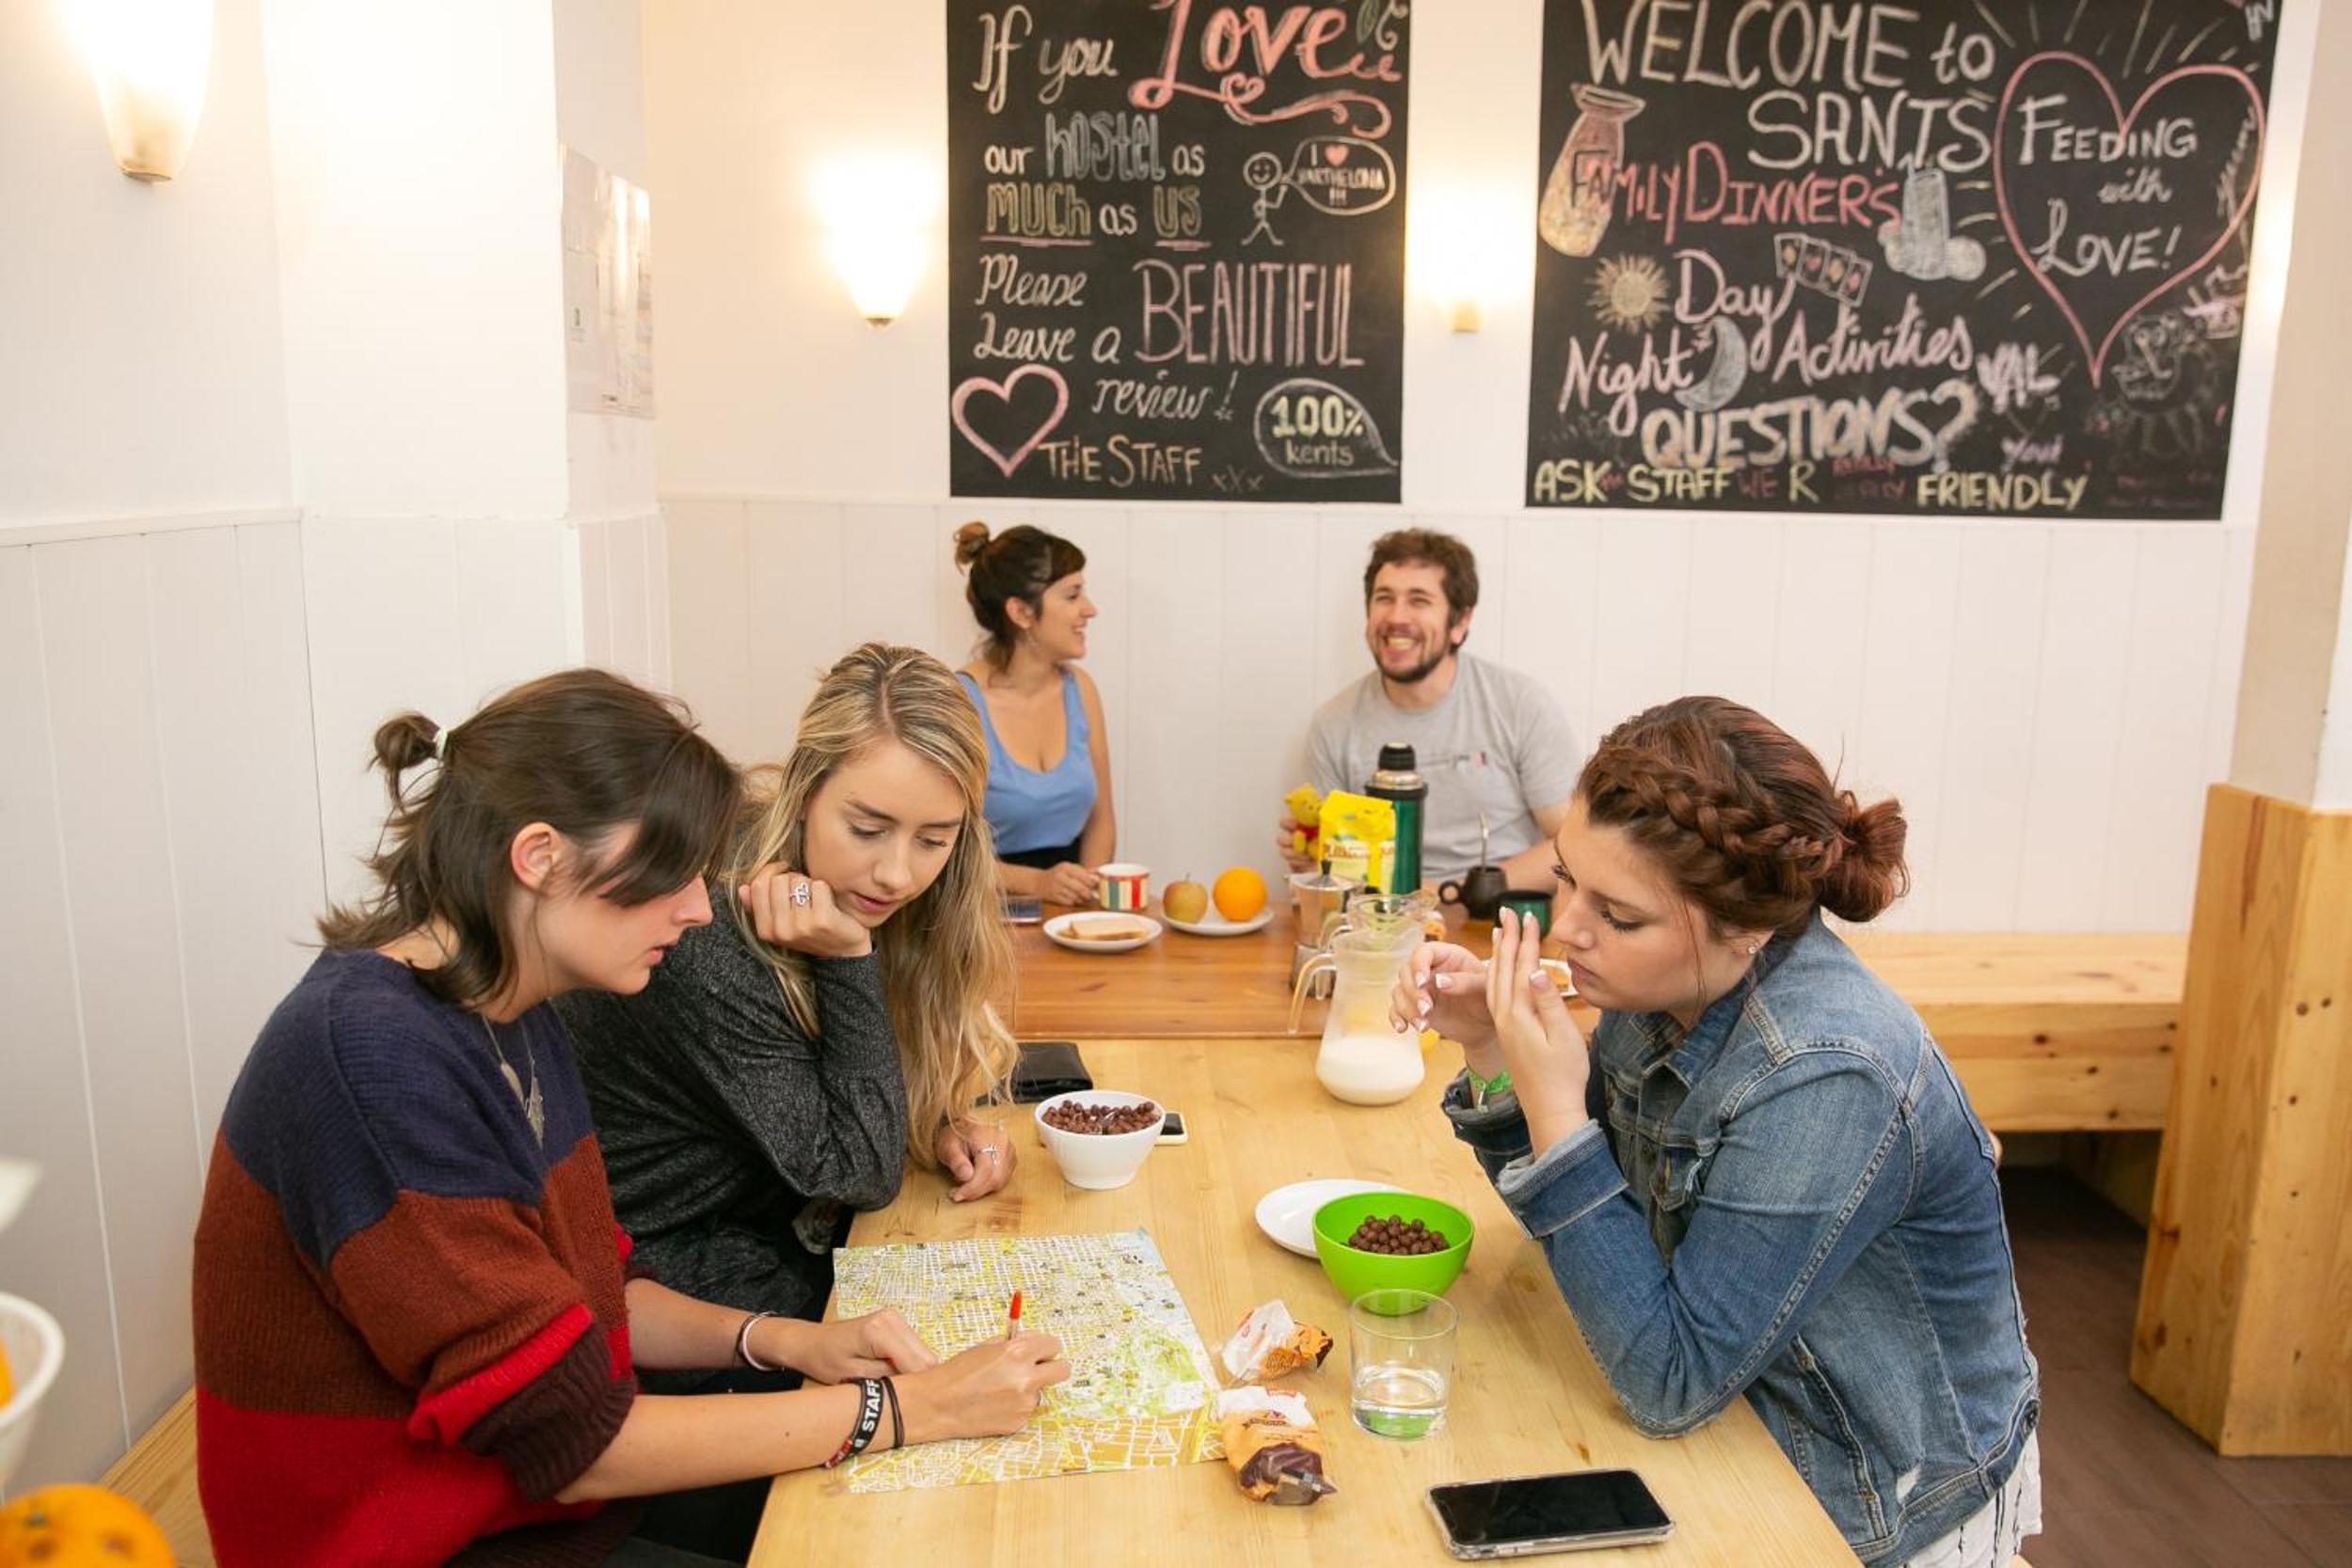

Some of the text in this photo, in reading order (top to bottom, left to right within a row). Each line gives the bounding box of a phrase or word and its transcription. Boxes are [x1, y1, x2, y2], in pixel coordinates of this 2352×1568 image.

[973, 0, 1402, 114] If you Love
[1582, 0, 1995, 92] WELCOME to
[1311, 143, 1317, 166] I
[1747, 90, 1992, 172] SANTS
[2016, 95, 2199, 166] FEEDING
[985, 146, 1035, 174] our
[1172, 144, 1205, 176] as
[2097, 167, 2172, 204] with
[1099, 203, 1137, 235] as
[975, 254, 1087, 306] Please
[974, 259, 1364, 368] Leave a BEAUTIFUL
[1674, 249, 1795, 372] Day
[1558, 325, 1694, 436] Night
[1270, 395, 1365, 436] 100%
[1641, 378, 1979, 472] QUESTIONS?
[1038, 436, 1102, 482] THE
[1106, 435, 1203, 487] STAFF
[1534, 458, 1611, 503] ASK
[1627, 463, 1735, 503] STAFF
[1789, 459, 1820, 503] R
[1915, 470, 2090, 511] FRIENDLY
[862, 1379, 882, 1433] STAFF
